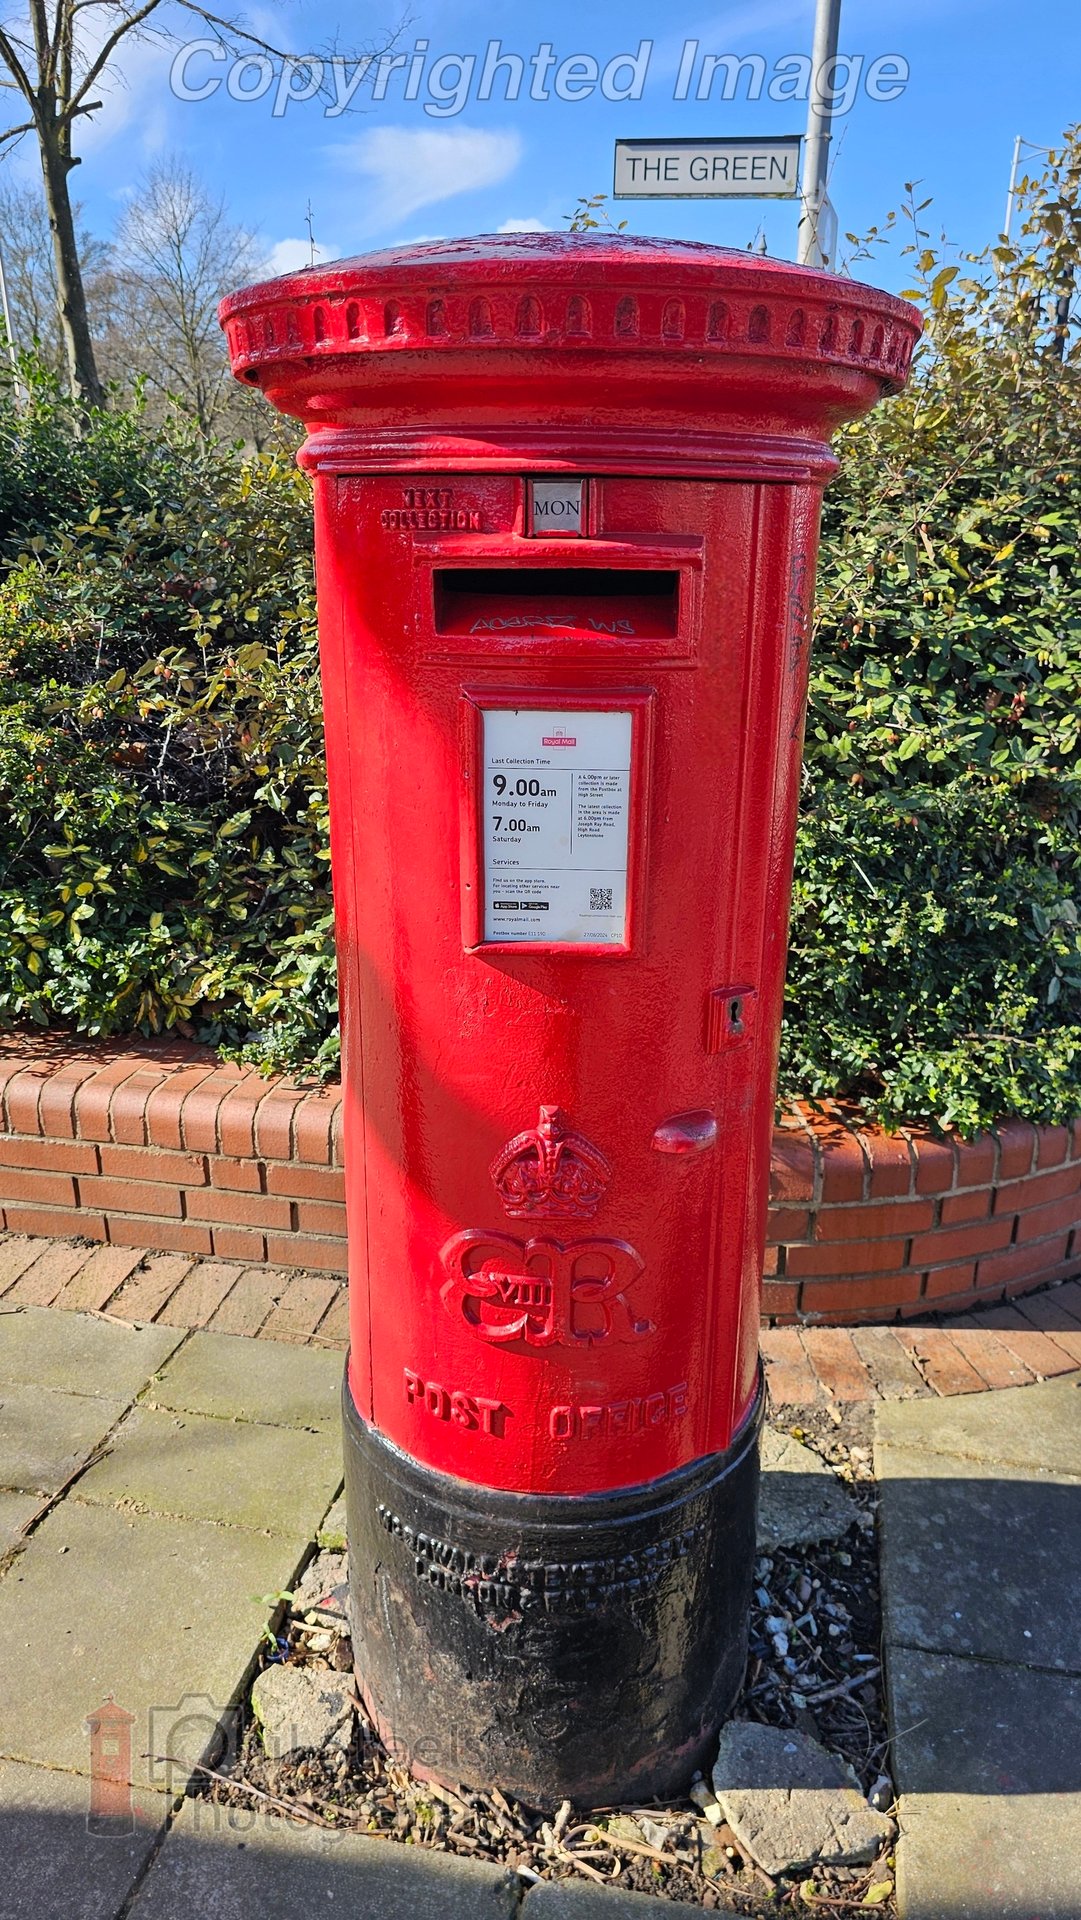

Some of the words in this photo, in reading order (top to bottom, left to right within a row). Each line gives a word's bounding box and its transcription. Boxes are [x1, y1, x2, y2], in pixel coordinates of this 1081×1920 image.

[626, 157, 680, 182] THE
[689, 155, 788, 182] GREEN
[402, 487, 453, 508] NEXT
[533, 500, 581, 516] MON
[380, 510, 481, 530] COLLECTION
[543, 738, 561, 746] Royal
[505, 757, 535, 765] Collection
[492, 774, 557, 797] 9.00am
[492, 800, 517, 808] Monday
[528, 801, 549, 809] Friday
[492, 816, 540, 832] 7.00am
[492, 836, 522, 844] Saturday
[492, 858, 520, 866] Services
[403, 1366, 508, 1437] POST
[549, 1381, 689, 1439] OFFICE
